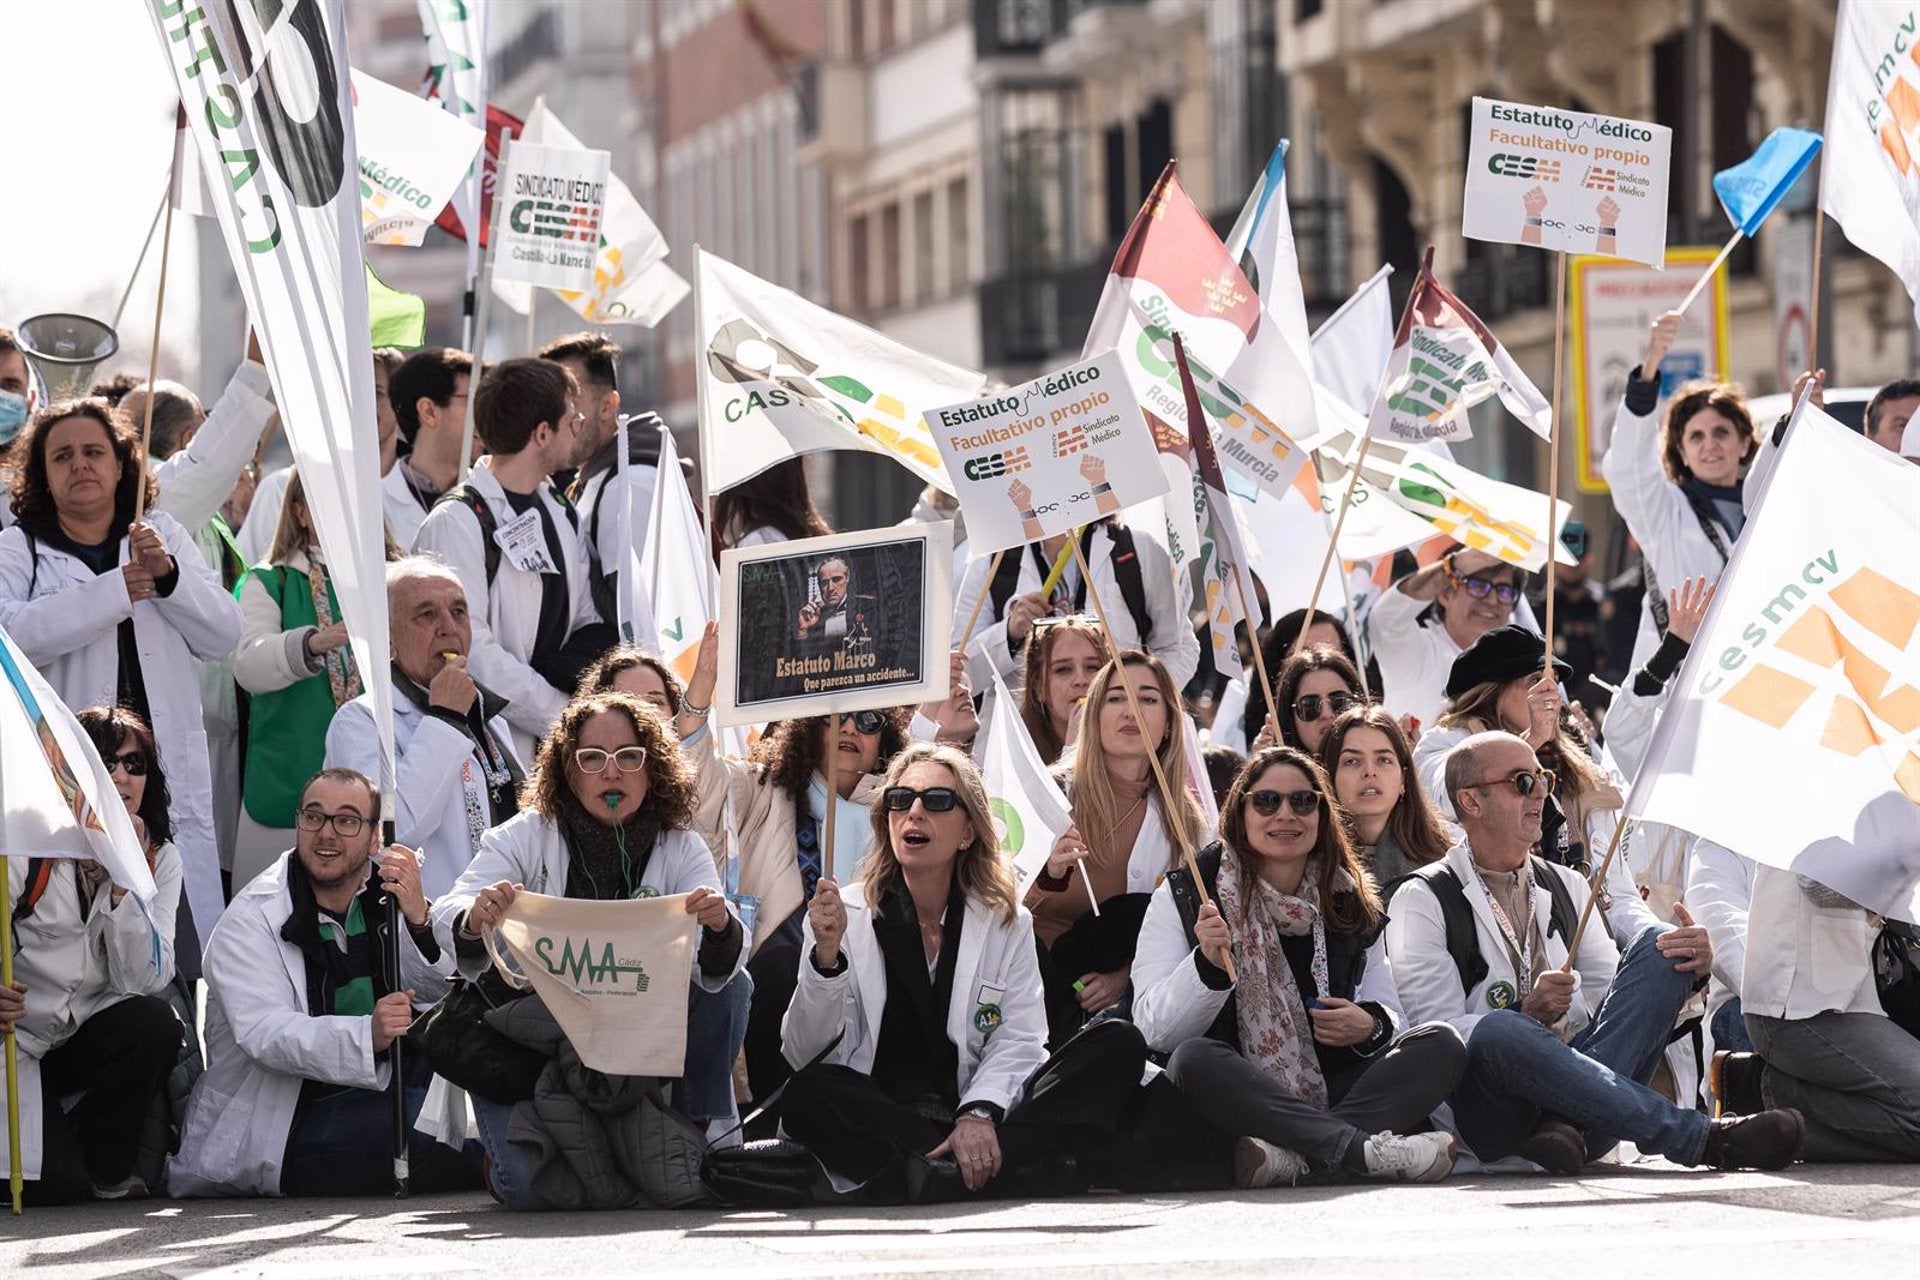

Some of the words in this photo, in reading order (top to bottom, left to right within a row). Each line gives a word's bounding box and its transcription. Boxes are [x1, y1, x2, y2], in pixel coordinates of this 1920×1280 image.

[1866, 11, 1916, 135] cemcv
[1490, 104, 1574, 131] Estatuto
[1489, 128, 1589, 156] Facultativo
[1594, 146, 1651, 166] propio
[1487, 153, 1561, 183] CESM
[1616, 170, 1650, 187] Sindicato
[515, 173, 566, 199] SINDICATO
[1618, 185, 1646, 198] Médico
[939, 396, 1020, 427] Estatuto
[950, 414, 1046, 452] Facultativo
[1050, 391, 1110, 426] propio
[1083, 413, 1121, 434] Sindicato
[1091, 428, 1122, 446] Médico
[964, 445, 1032, 481] CESM
[1221, 436, 1280, 482] Murcia
[1698, 549, 1839, 695] cesmcv
[776, 655, 831, 678] Estatuto
[834, 651, 876, 671] Marco
[803, 678, 820, 692] Que
[821, 674, 853, 690] parezca
[854, 673, 865, 685] un
[867, 667, 915, 681] accidente...
[535, 937, 618, 986] SMA
